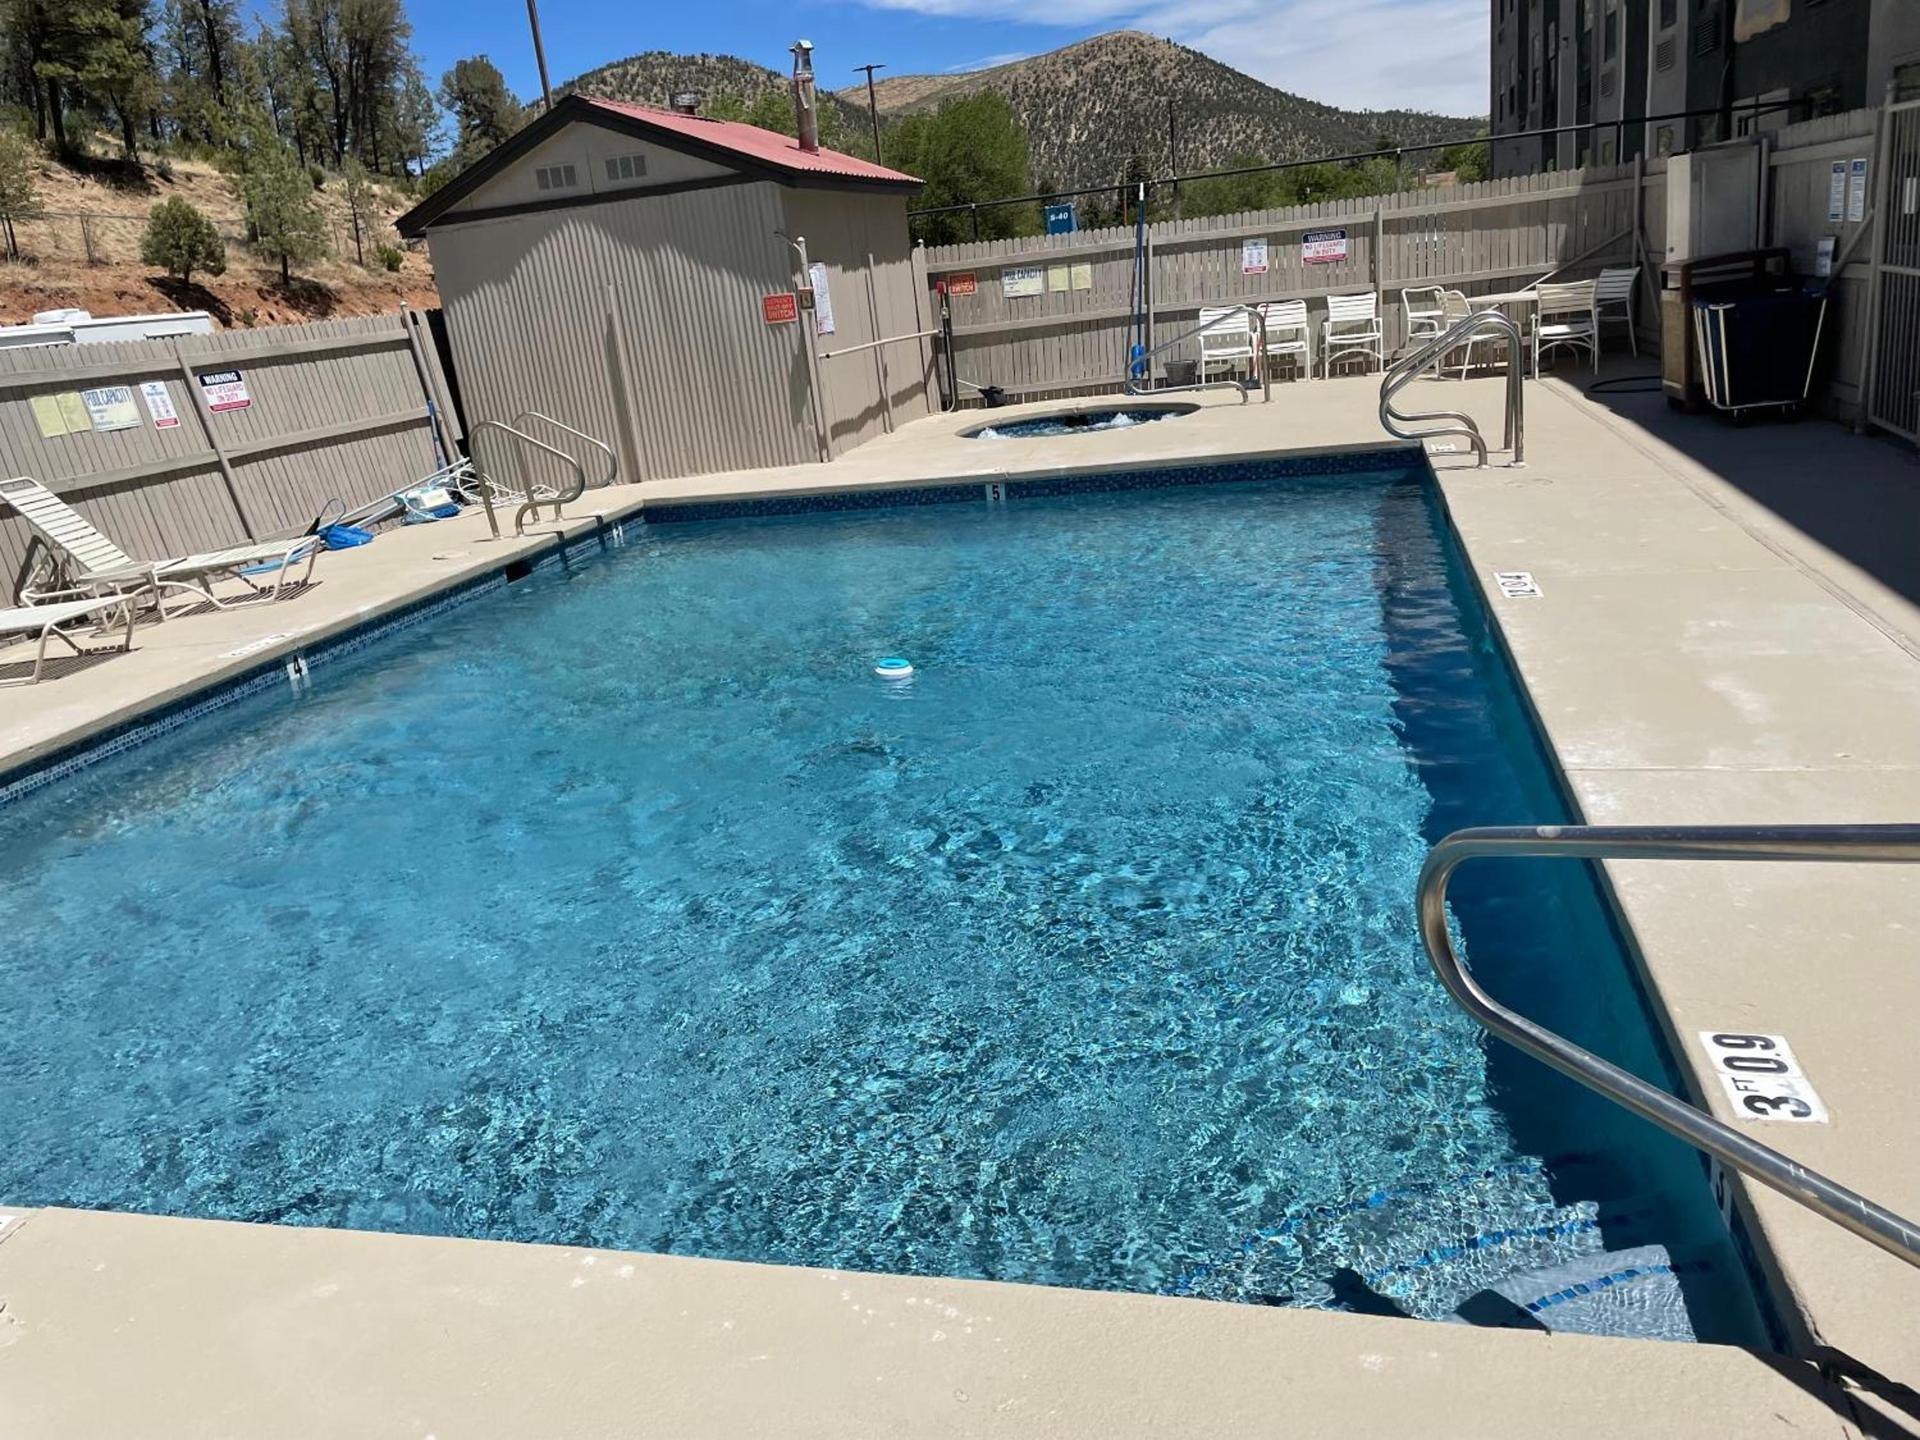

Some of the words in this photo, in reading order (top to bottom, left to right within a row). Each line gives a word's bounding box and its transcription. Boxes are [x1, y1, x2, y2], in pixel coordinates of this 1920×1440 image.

[1050, 212, 1069, 221] S-40
[1307, 232, 1341, 242] WARNING
[1017, 269, 1041, 280] CAPACITY
[768, 309, 794, 319] SWITCH
[203, 372, 238, 385] WARNING
[206, 388, 216, 396] NO
[216, 384, 244, 395] LIFEGUARD
[84, 391, 102, 406] POOL
[101, 387, 132, 405] CAPACITY
[225, 393, 239, 401] DUTY
[992, 484, 1000, 501] 5
[293, 655, 303, 677] 4
[1732, 1077, 1759, 1093] FT
[1743, 1094, 1812, 1118] 3
